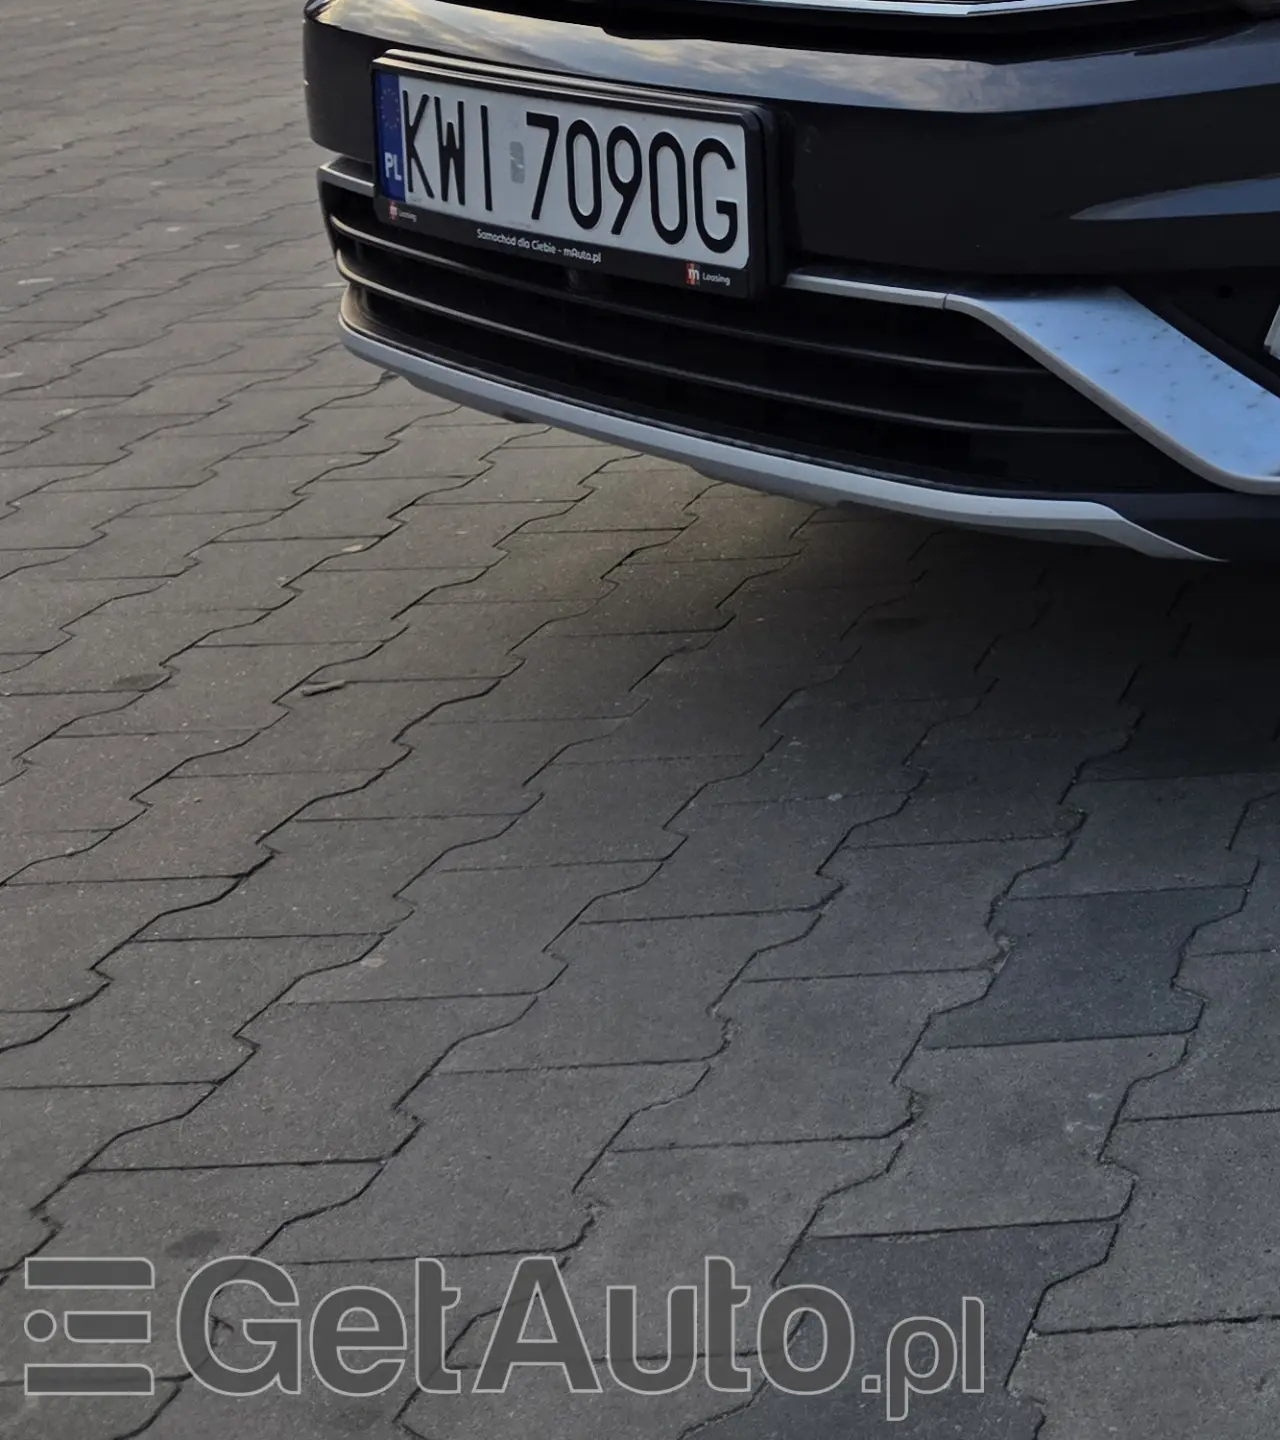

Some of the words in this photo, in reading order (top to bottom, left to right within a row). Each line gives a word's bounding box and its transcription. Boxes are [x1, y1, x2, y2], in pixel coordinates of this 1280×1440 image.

[384, 151, 402, 181] PL
[402, 90, 493, 211] KWI
[526, 111, 739, 254] 7090G
[476, 228, 516, 246] Samochód
[517, 238, 530, 249] dla
[531, 240, 556, 254] Ciebie
[563, 248, 601, 264] mAuto.pl
[702, 272, 731, 286] Leasing
